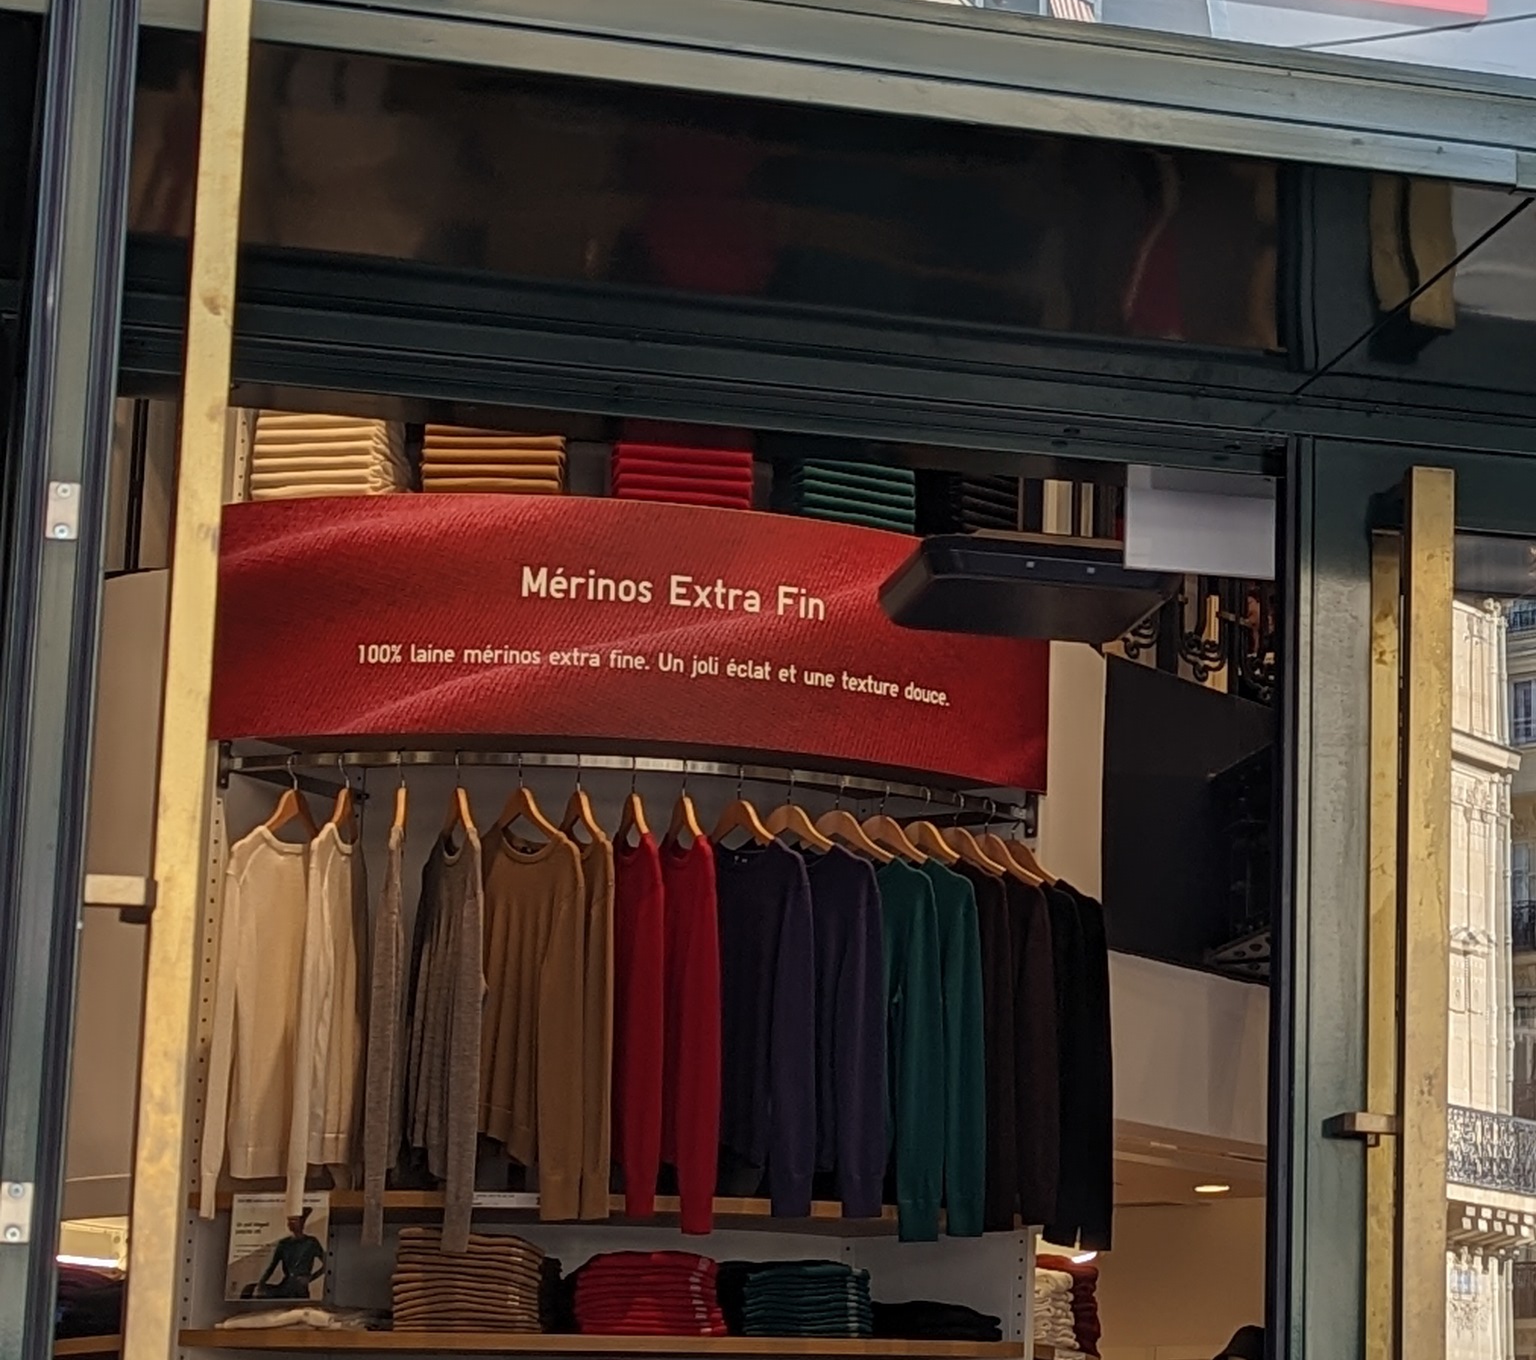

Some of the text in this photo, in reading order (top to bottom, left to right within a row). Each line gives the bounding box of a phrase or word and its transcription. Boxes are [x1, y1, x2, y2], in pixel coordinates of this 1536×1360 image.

[521, 566, 825, 621] Mérinos Extra Fin
[358, 644, 950, 707] 100% laine mérinos extra fine. Un joli éclat et une texture douce.
